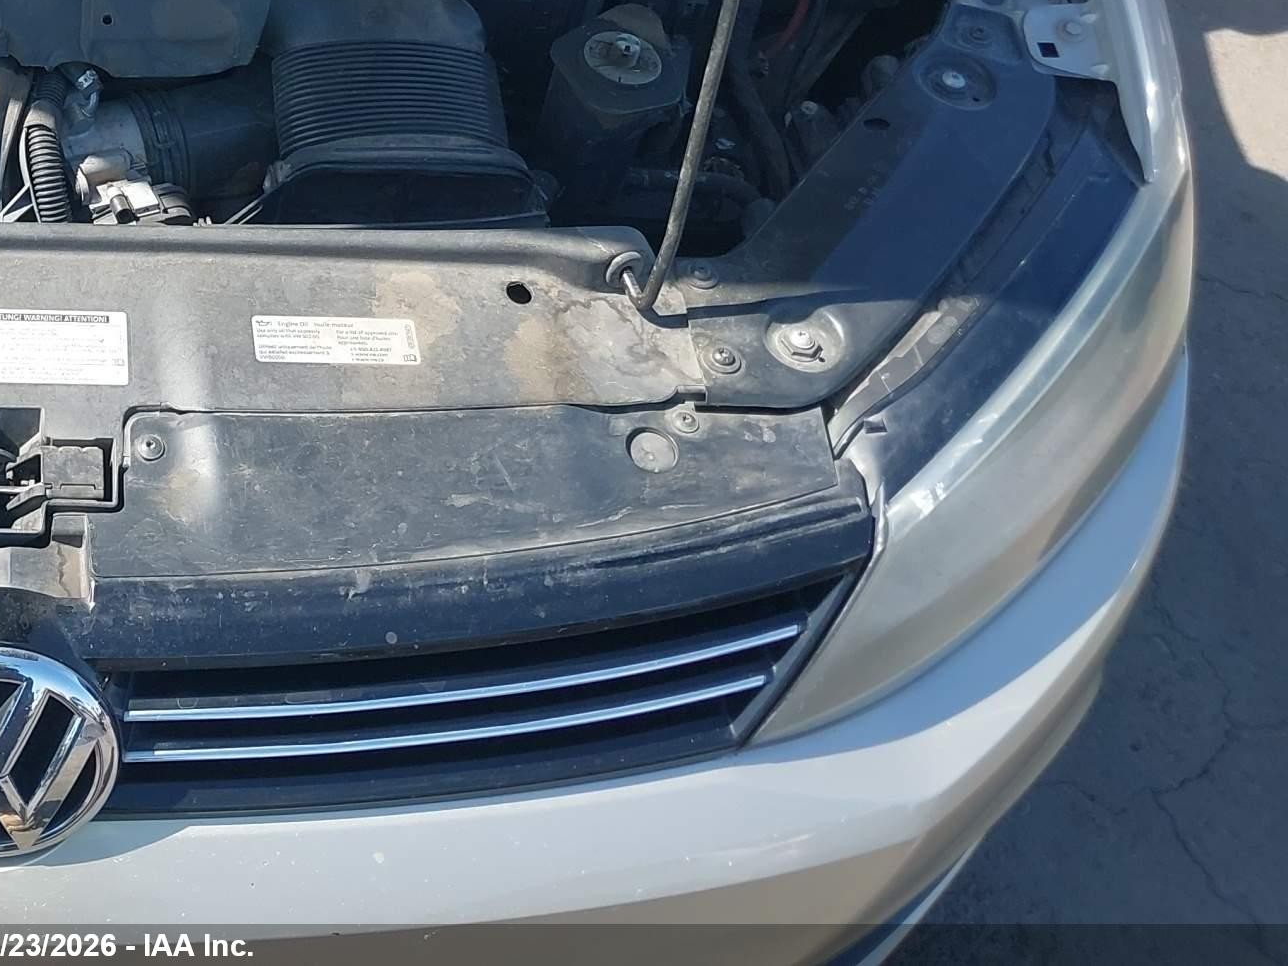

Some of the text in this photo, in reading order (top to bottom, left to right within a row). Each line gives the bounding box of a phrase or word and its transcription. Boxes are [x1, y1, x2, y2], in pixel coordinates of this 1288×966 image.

[23, 314, 63, 323] WARNING!
[64, 315, 108, 324] ATTENTION!
[277, 320, 299, 328] Engine
